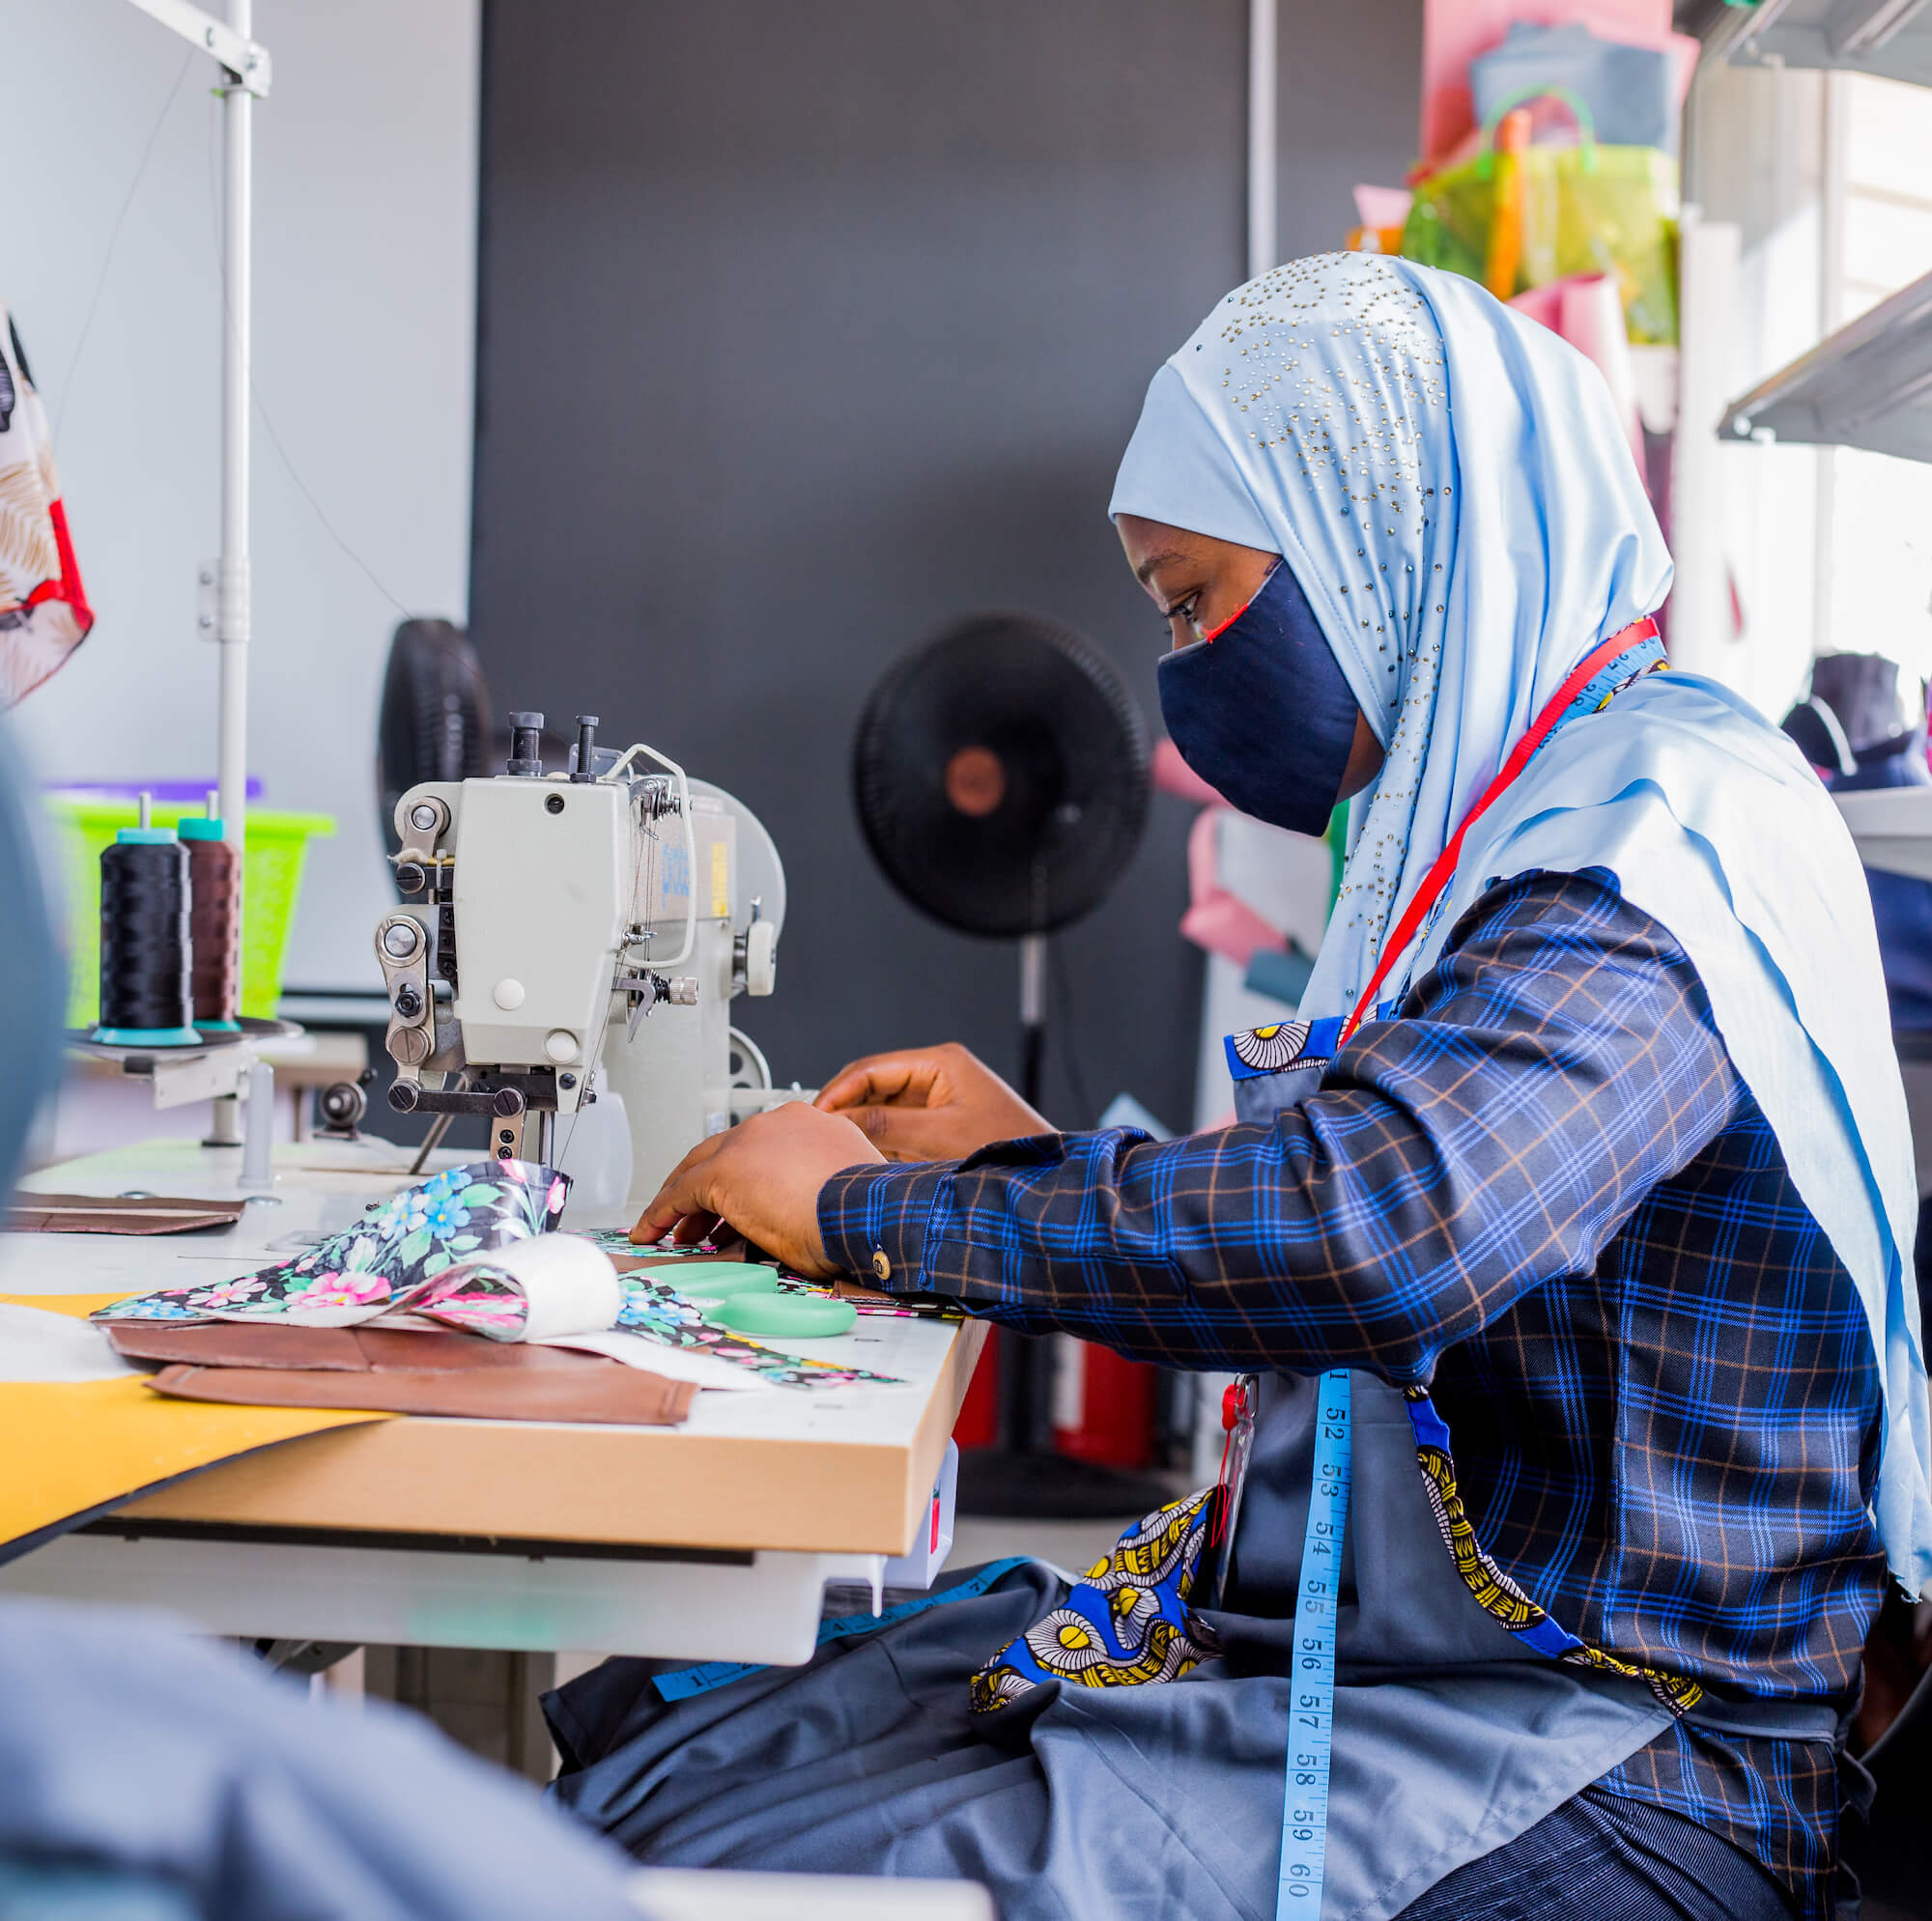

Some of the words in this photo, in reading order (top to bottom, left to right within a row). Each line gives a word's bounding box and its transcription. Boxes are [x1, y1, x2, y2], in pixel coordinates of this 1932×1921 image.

[1324, 1406, 1346, 1440] 52
[1320, 1462, 1342, 1498] 53
[1312, 1521, 1334, 1556] 54
[1304, 1579, 1327, 1615] 55
[1301, 1637, 1322, 1671] 56
[1298, 1694, 1321, 1730] 57
[1295, 1753, 1318, 1786] 58
[1293, 1809, 1315, 1842] 59
[1288, 1864, 1311, 1899] 60
